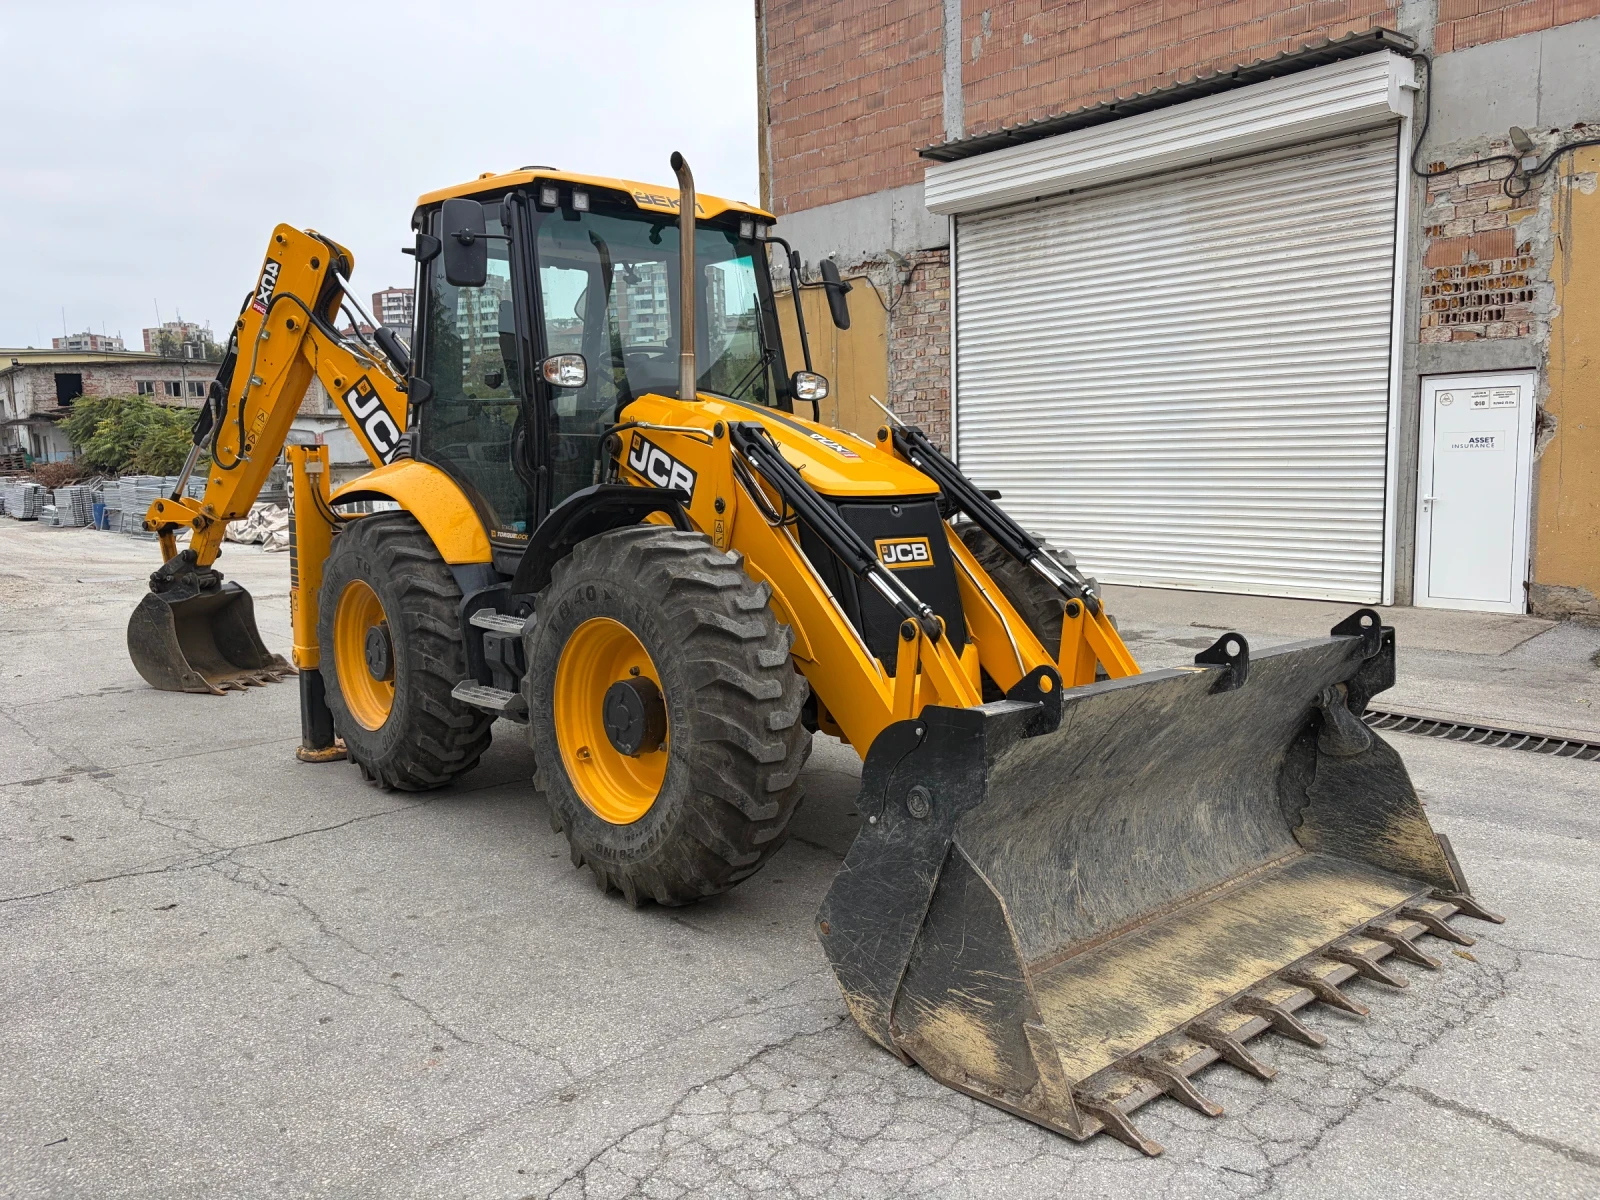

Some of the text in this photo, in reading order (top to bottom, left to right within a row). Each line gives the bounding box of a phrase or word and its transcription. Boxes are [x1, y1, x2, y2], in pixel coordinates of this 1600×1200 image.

[256, 262, 279, 304] 4CX
[347, 389, 400, 465] JC
[286, 464, 295, 514] 4CX
[629, 441, 694, 503] JCB
[882, 543, 929, 562] JCB
